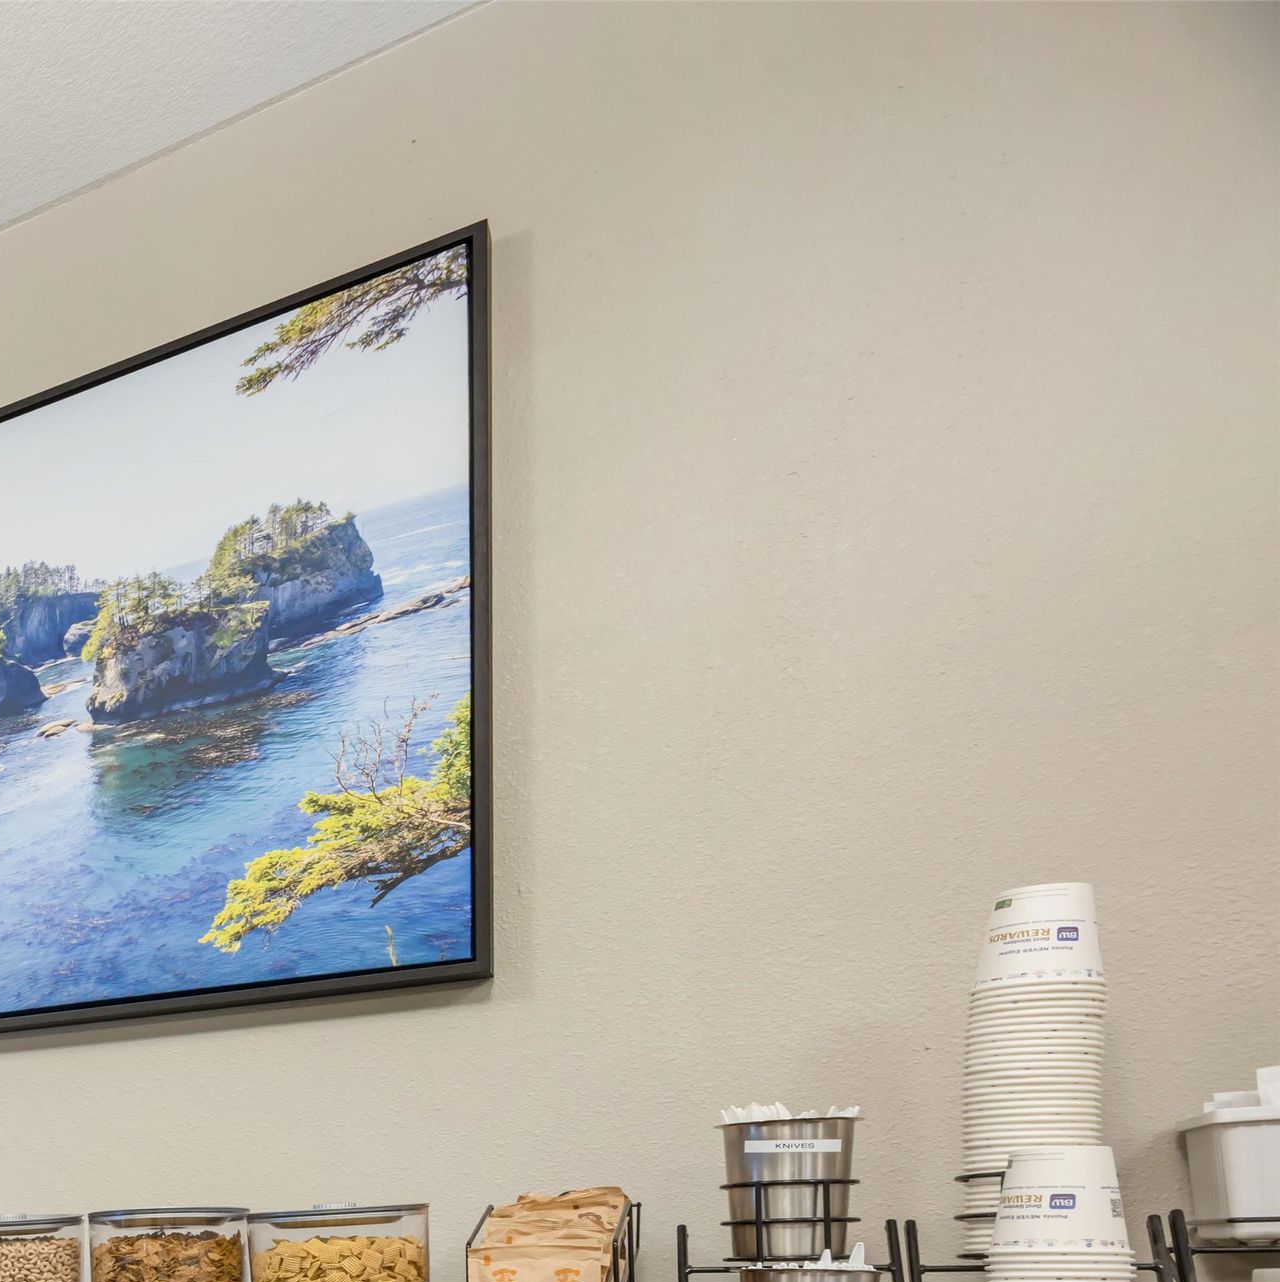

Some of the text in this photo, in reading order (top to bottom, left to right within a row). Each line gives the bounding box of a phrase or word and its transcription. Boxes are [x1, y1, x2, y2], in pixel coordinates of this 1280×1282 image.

[988, 928, 1050, 944] REWARDS
[1058, 931, 1077, 939] BW
[1052, 1199, 1073, 1207] BW
